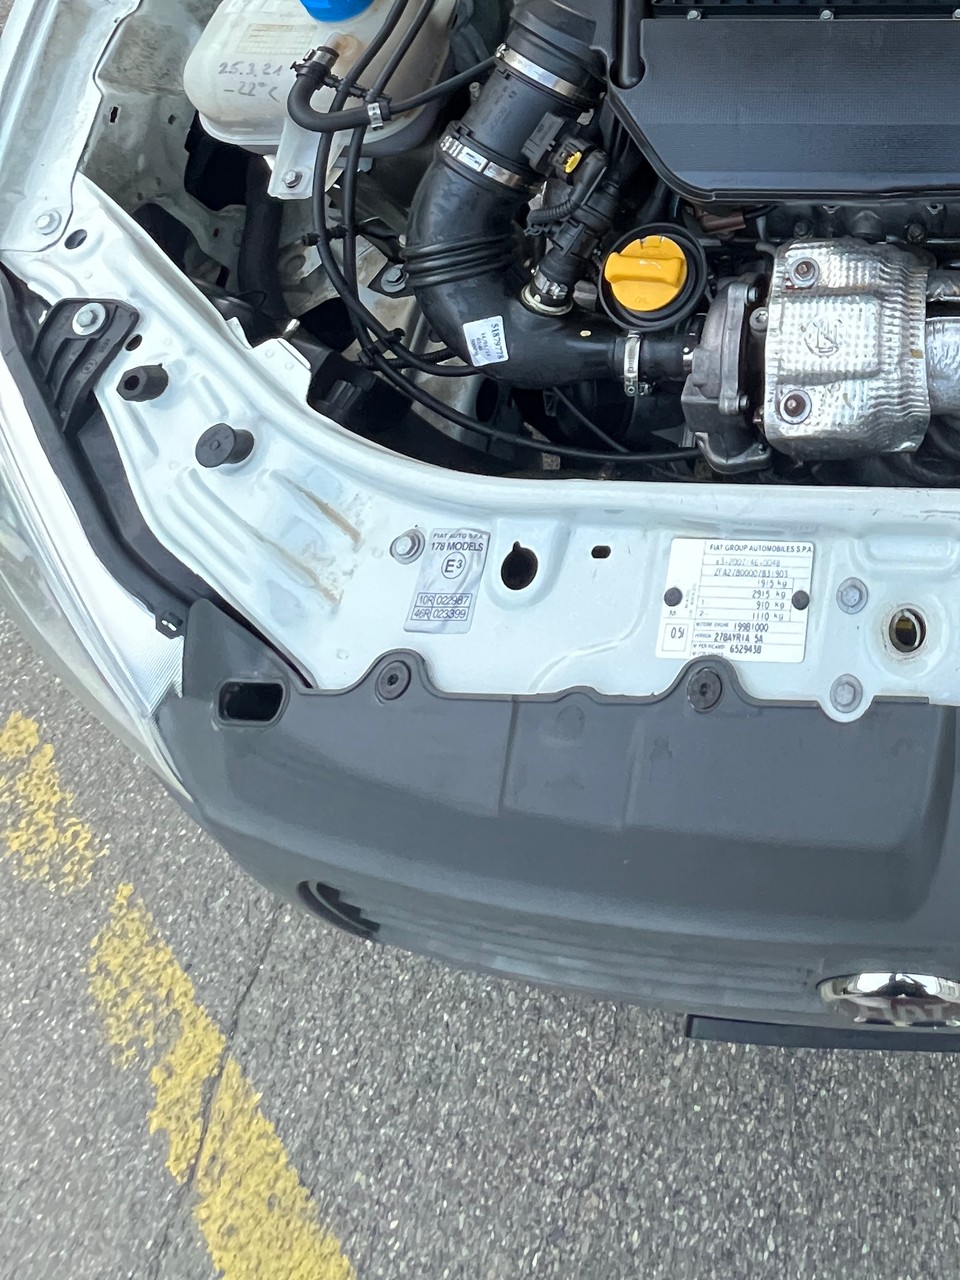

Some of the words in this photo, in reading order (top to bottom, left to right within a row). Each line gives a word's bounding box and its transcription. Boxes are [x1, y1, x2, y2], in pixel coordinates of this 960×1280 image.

[431, 542, 445, 551] 178
[446, 542, 484, 552] MODELS
[724, 544, 748, 552] GROUP
[749, 545, 795, 553] AUTOMOBILES
[757, 579, 775, 589] 1915
[777, 580, 788, 589] kg
[752, 589, 771, 599] 2915
[775, 590, 786, 599] kg
[436, 594, 470, 606] 022987
[756, 600, 770, 610] 910
[774, 601, 785, 610] kg
[432, 608, 467, 619] 023399
[752, 612, 770, 621] 1110
[729, 644, 762, 654] 6529438
